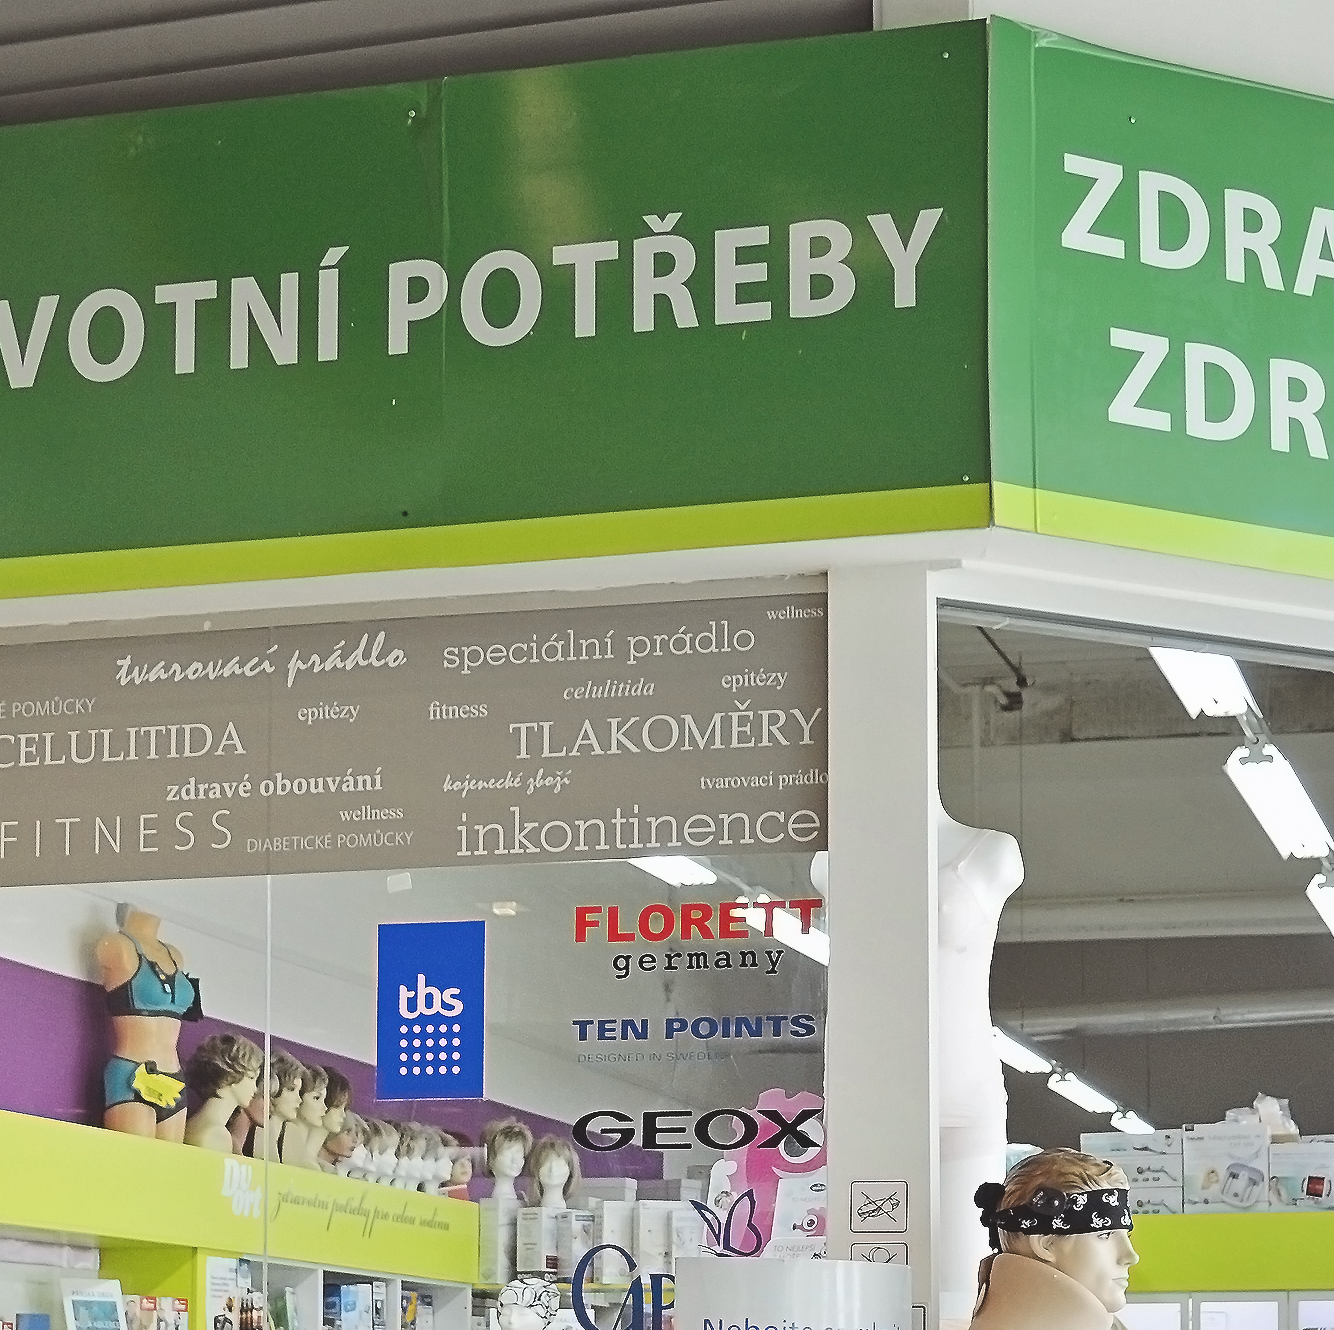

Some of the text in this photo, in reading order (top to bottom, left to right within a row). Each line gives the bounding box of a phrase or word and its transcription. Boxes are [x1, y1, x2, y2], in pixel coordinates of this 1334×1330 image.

[388, 208, 944, 356] POTŘEBY
[766, 604, 824, 620] wellness
[115, 631, 407, 688] tvarovací prádlo
[442, 621, 756, 674] speciální prádlo
[563, 678, 656, 701] celulitida
[721, 668, 788, 694] epitézy
[10, 697, 96, 720] POMŮCKY
[297, 700, 360, 725] epitézy
[428, 698, 488, 722] fitness
[509, 700, 821, 758] TLAKOMĚRY
[166, 766, 383, 801] zdravé obouvání
[442, 767, 572, 794] kojenecké zboží
[699, 767, 828, 790] tvarovací prádlo
[339, 803, 404, 822] wellness
[0, 809, 233, 859] FITNESS
[247, 828, 414, 852] DIABETICKÉ POMŮCKY
[456, 805, 820, 857] inkontinence
[574, 898, 823, 943] FLORETT
[612, 947, 784, 979] germany
[398, 974, 464, 1020] tbs
[571, 1014, 817, 1041] TEN POINTS
[577, 1052, 645, 1064] DESIGNED
[571, 1108, 825, 1151] GEOX
